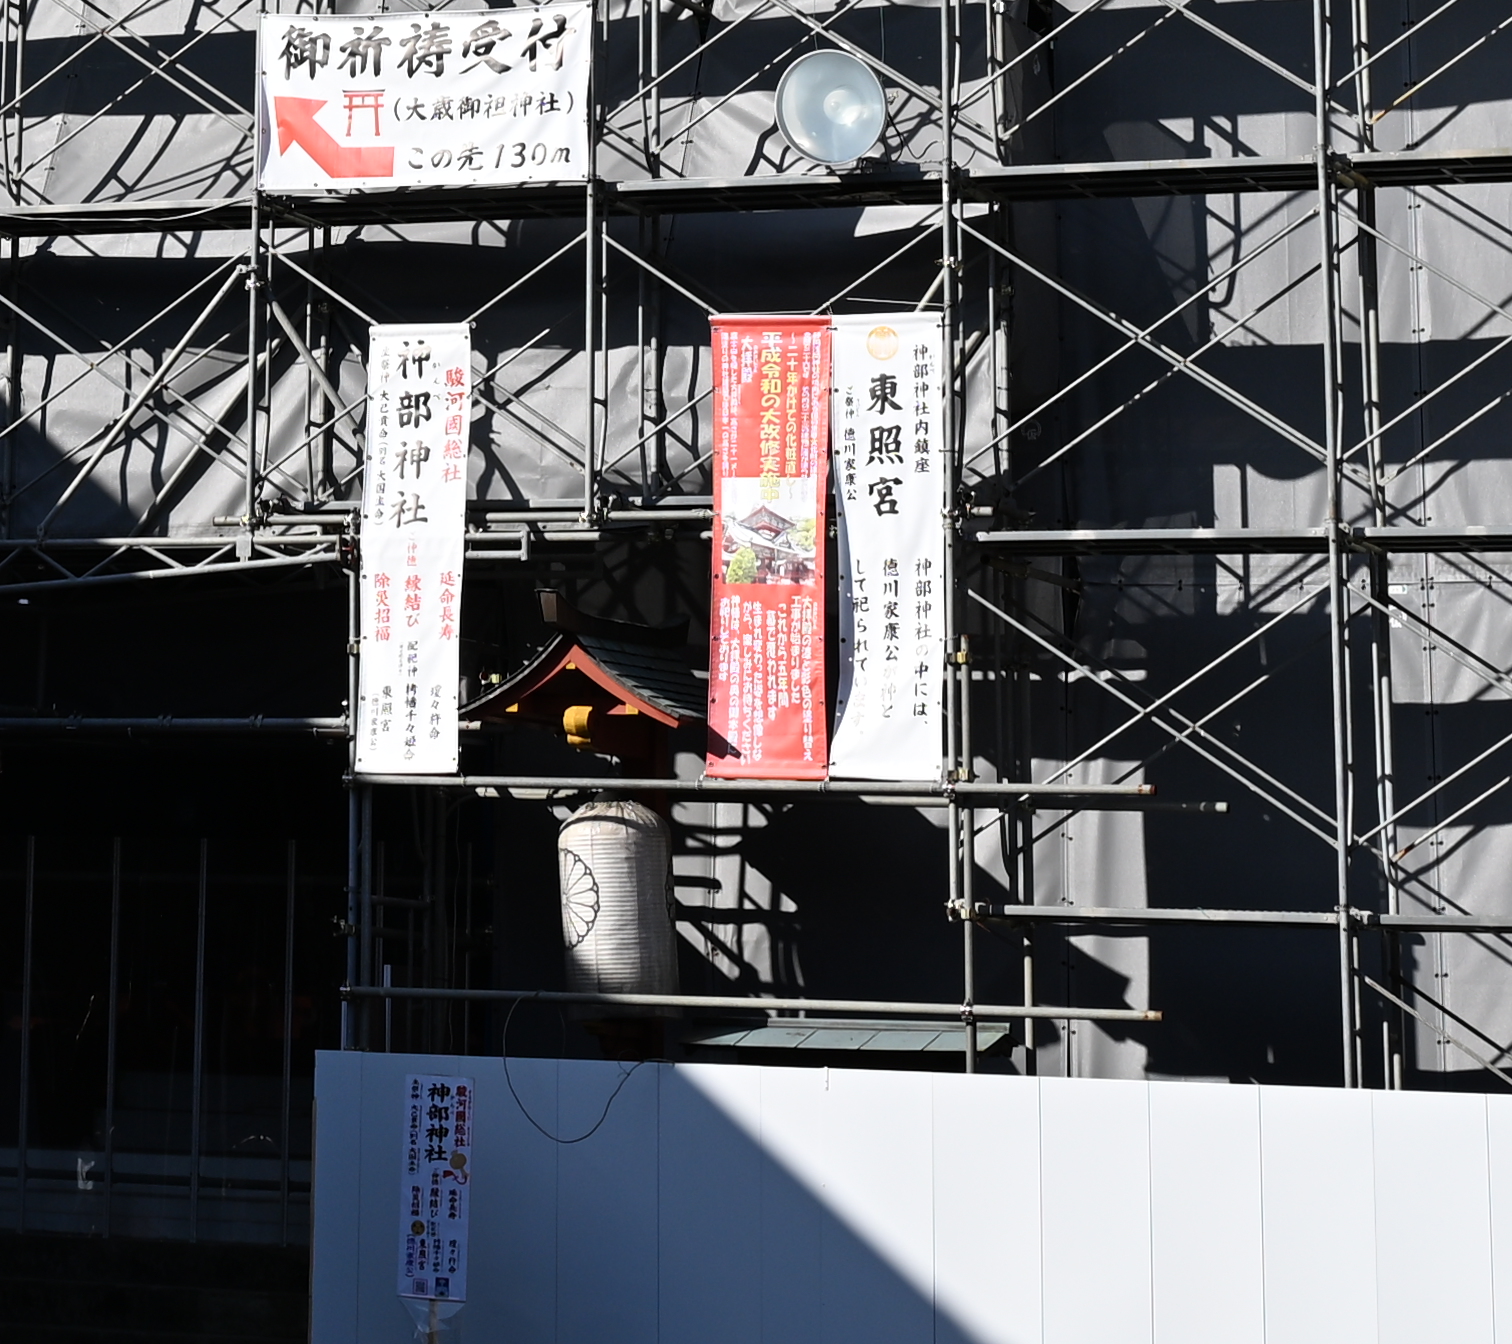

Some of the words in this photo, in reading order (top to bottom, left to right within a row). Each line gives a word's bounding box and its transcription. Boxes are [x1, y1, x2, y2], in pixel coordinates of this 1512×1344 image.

[278, 14, 576, 80] 御祈祷受付
[389, 340, 433, 528] 神部神社
[760, 332, 783, 504] 平成令和の大改修実施中
[865, 373, 905, 517] 東照宮
[913, 344, 931, 473] 神部神社内鎮座
[374, 572, 391, 642] 除災招福
[404, 575, 422, 627] 縁結び
[439, 571, 456, 640] 延命長寿
[777, 603, 789, 708] これから五年間
[424, 1083, 451, 1164] 神部神社
